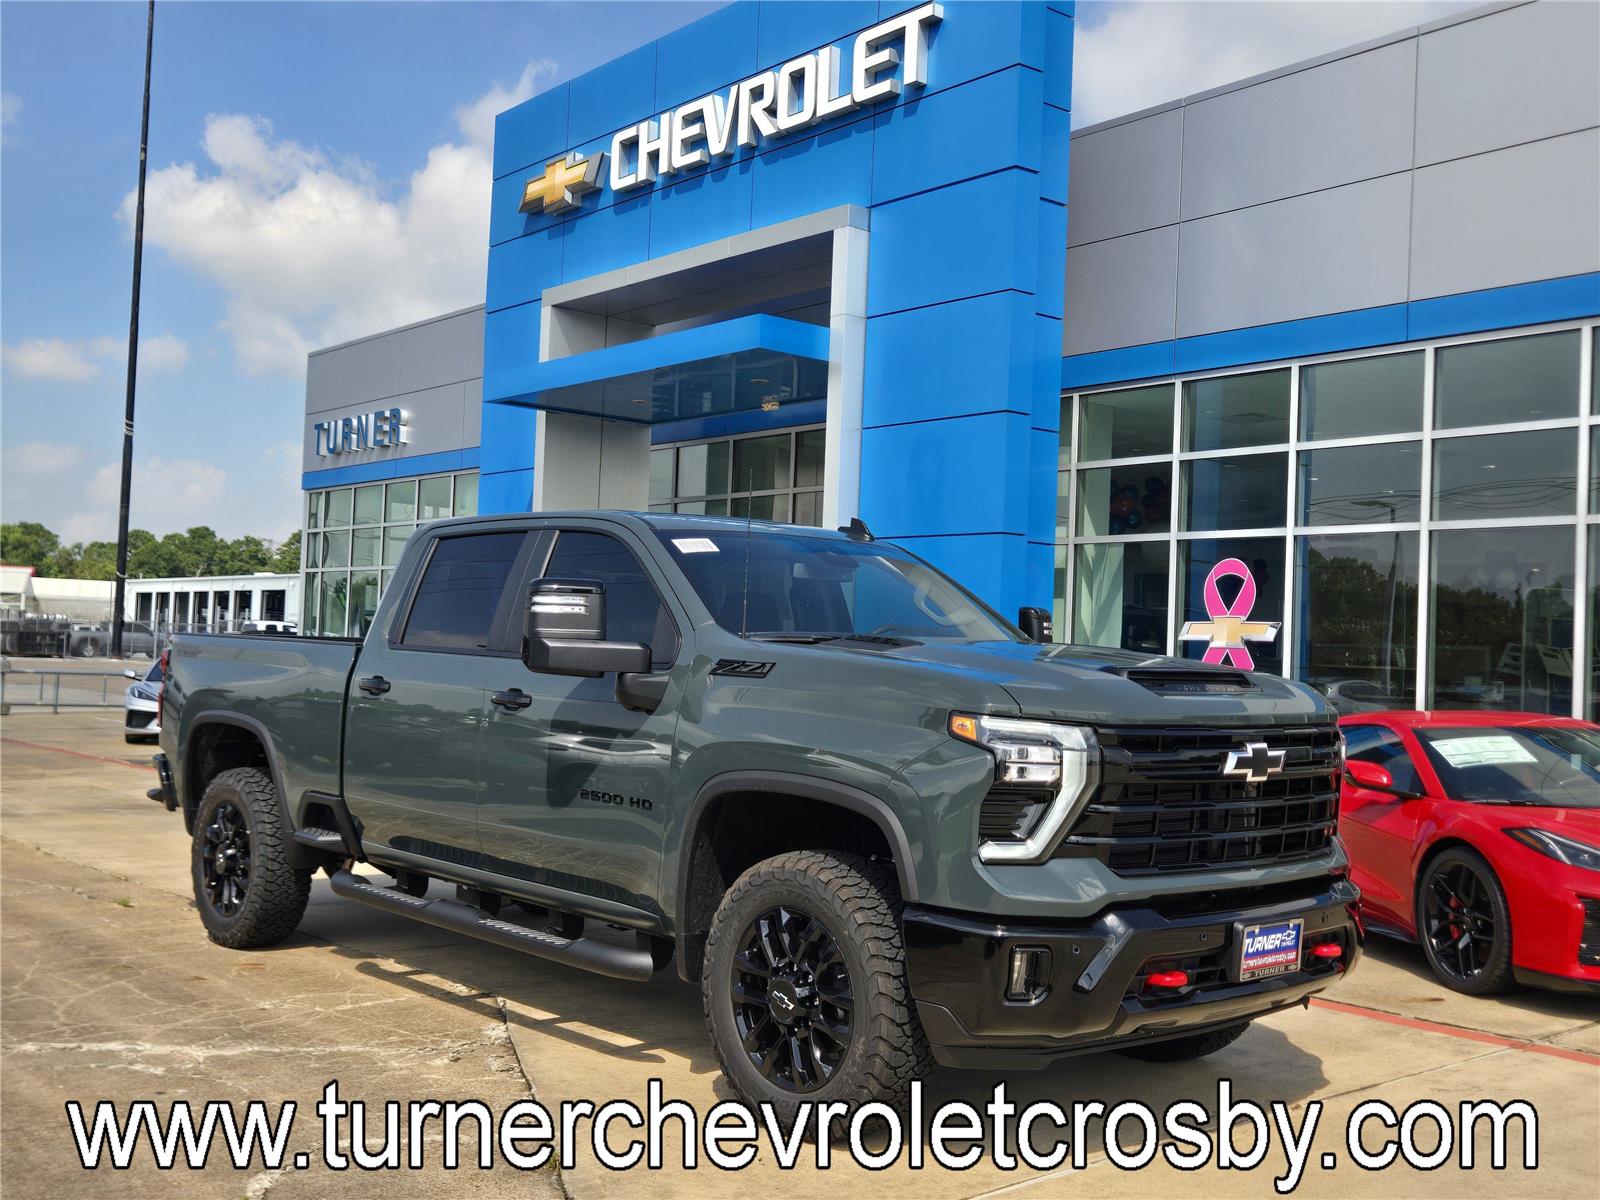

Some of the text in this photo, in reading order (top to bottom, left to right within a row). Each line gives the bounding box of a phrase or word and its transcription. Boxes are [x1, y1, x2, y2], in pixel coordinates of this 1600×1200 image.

[609, 2, 944, 193] CHEVROLET
[314, 408, 408, 457] TURNER
[709, 658, 777, 679] Z71
[579, 788, 653, 811] 2500 HD
[1244, 933, 1282, 954] TURNER
